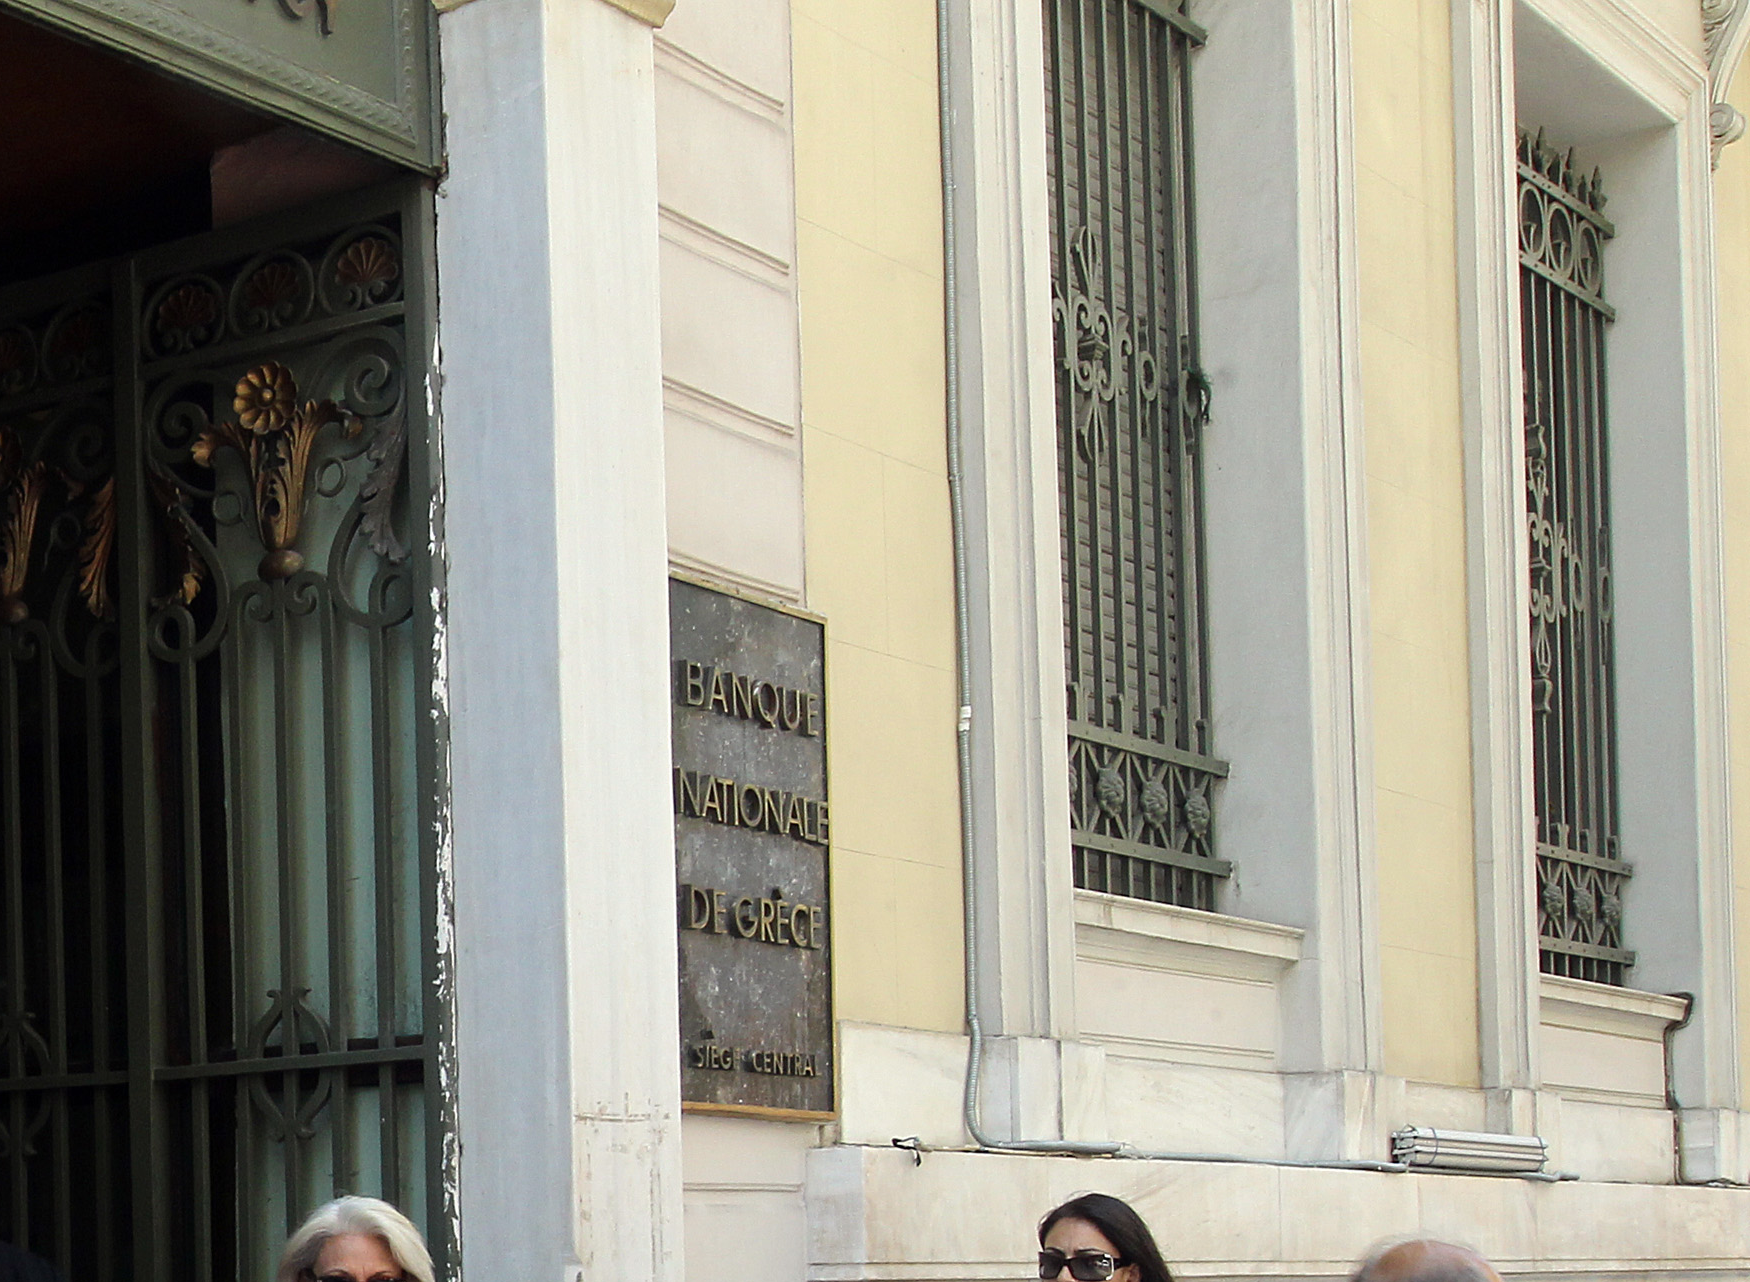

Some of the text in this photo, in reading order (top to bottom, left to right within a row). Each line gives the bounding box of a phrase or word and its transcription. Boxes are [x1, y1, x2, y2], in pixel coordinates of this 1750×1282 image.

[686, 660, 819, 738] BANQUE
[678, 767, 829, 843] NATIONALE
[690, 886, 728, 934] DE
[752, 1049, 823, 1077] CENTRAL
